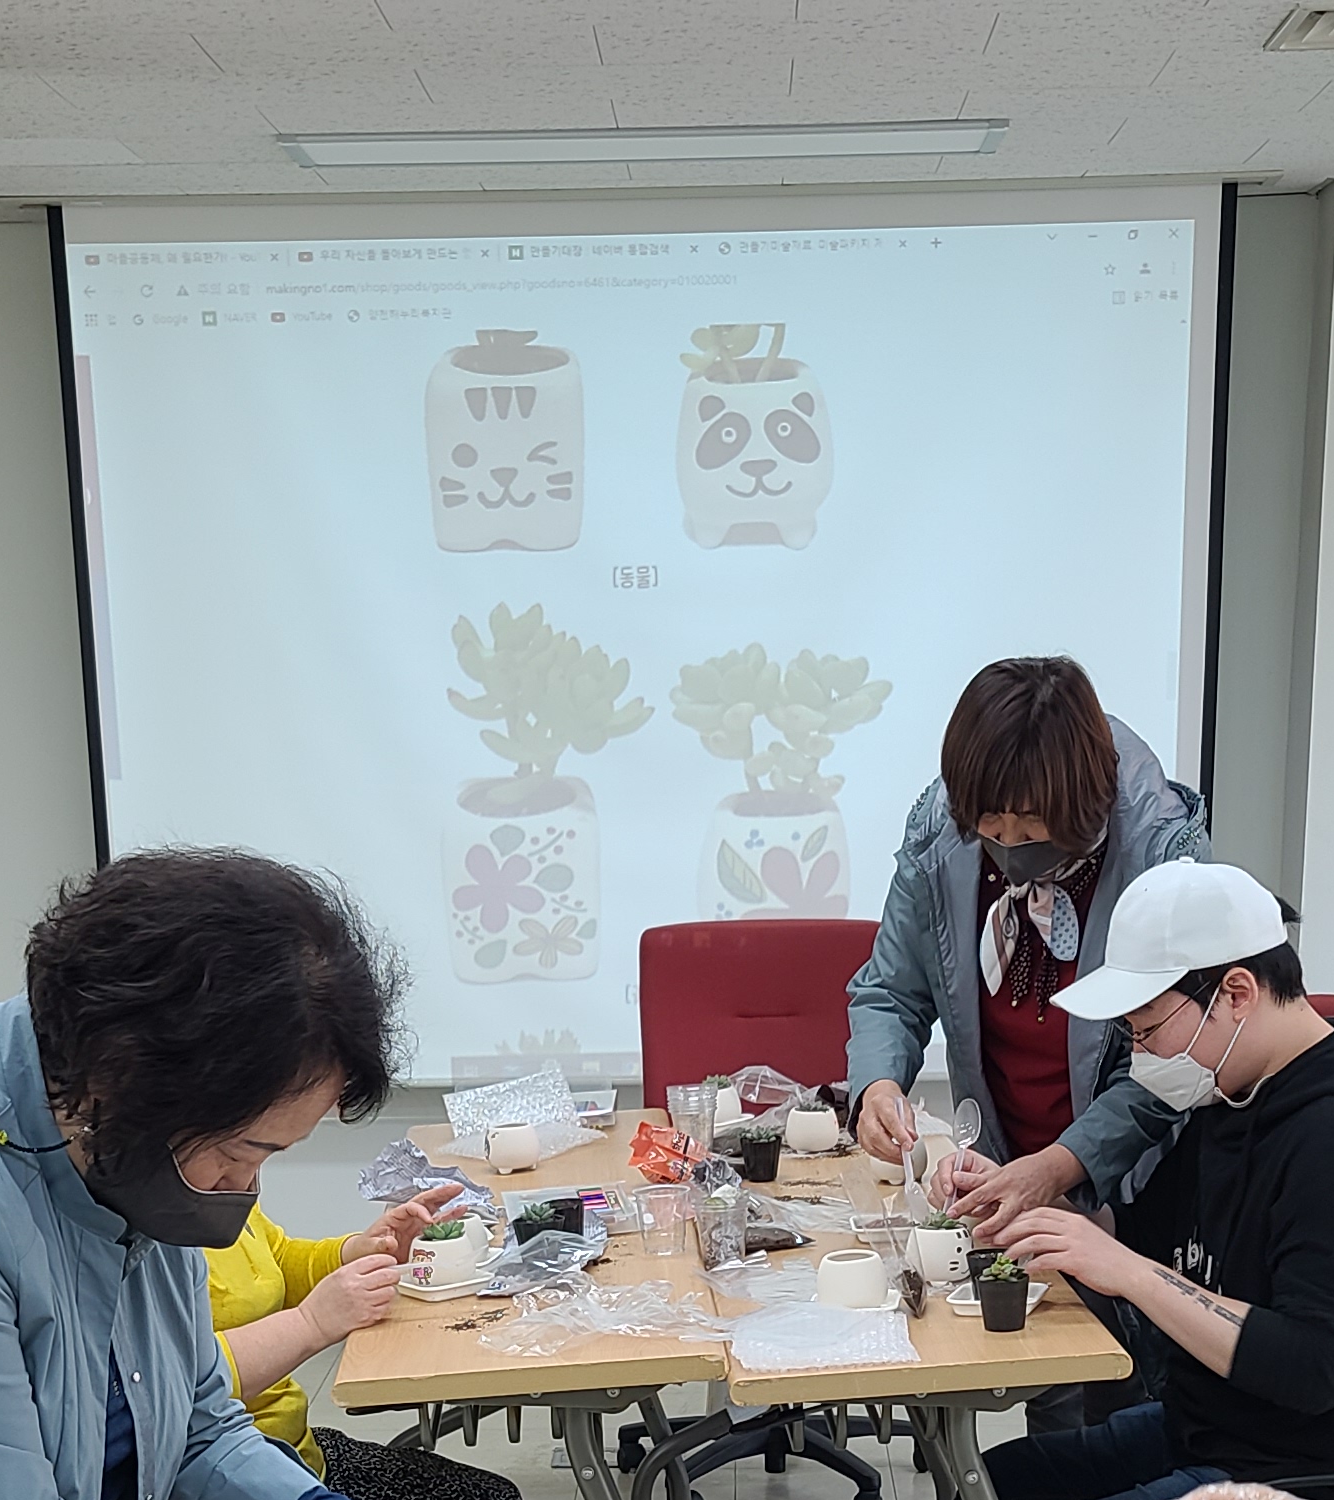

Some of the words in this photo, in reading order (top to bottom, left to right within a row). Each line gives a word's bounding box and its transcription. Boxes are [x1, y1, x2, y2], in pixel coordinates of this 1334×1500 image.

[320, 249, 341, 261] 우리
[345, 249, 376, 262] 자신을
[381, 248, 423, 261] 돌아보게
[426, 247, 459, 260] 만드는
[530, 244, 583, 258] 만들기대장
[592, 243, 624, 256] 네이버
[628, 242, 670, 256] 통합검색
[152, 312, 189, 327] Google
[291, 310, 334, 322] YouTube
[612, 565, 659, 590] [동물]
